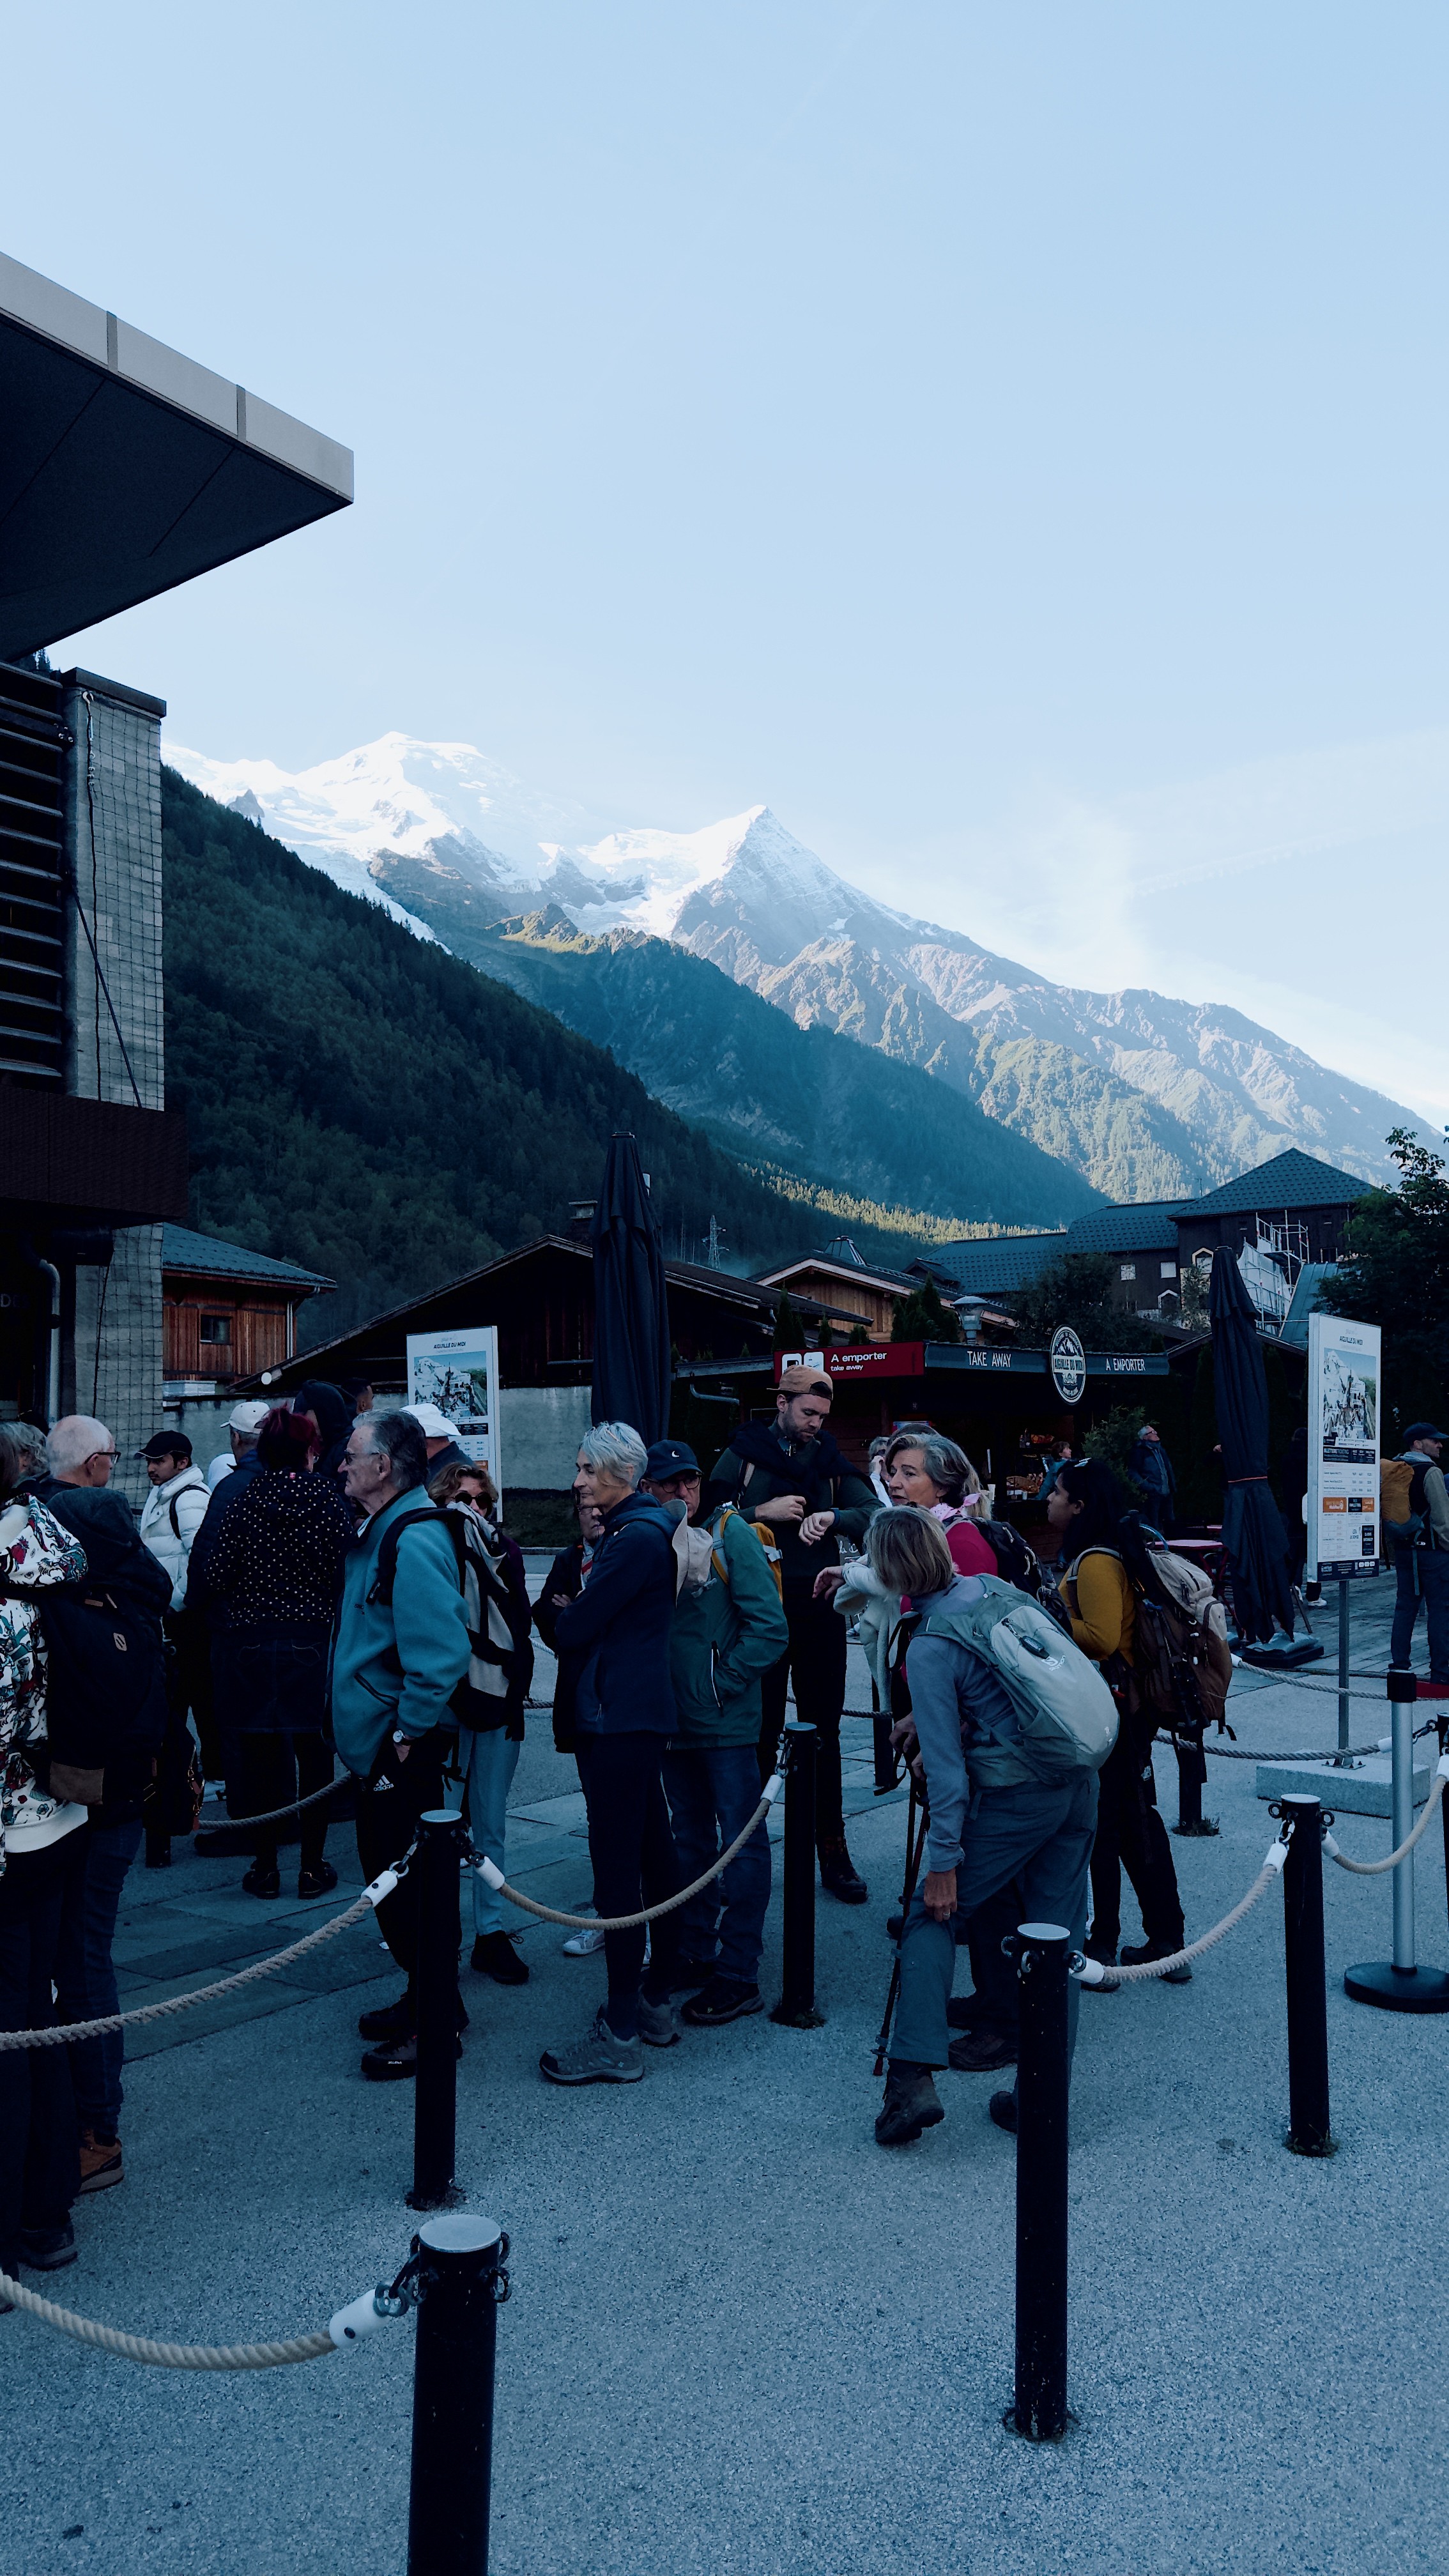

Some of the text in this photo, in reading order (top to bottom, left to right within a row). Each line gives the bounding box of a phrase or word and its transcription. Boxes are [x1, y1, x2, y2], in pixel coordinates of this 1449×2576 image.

[831, 1352, 887, 1363] A emporter
[967, 1351, 1011, 1368] TAKE AWAY
[1106, 1358, 1146, 1371] A EMPORTER
